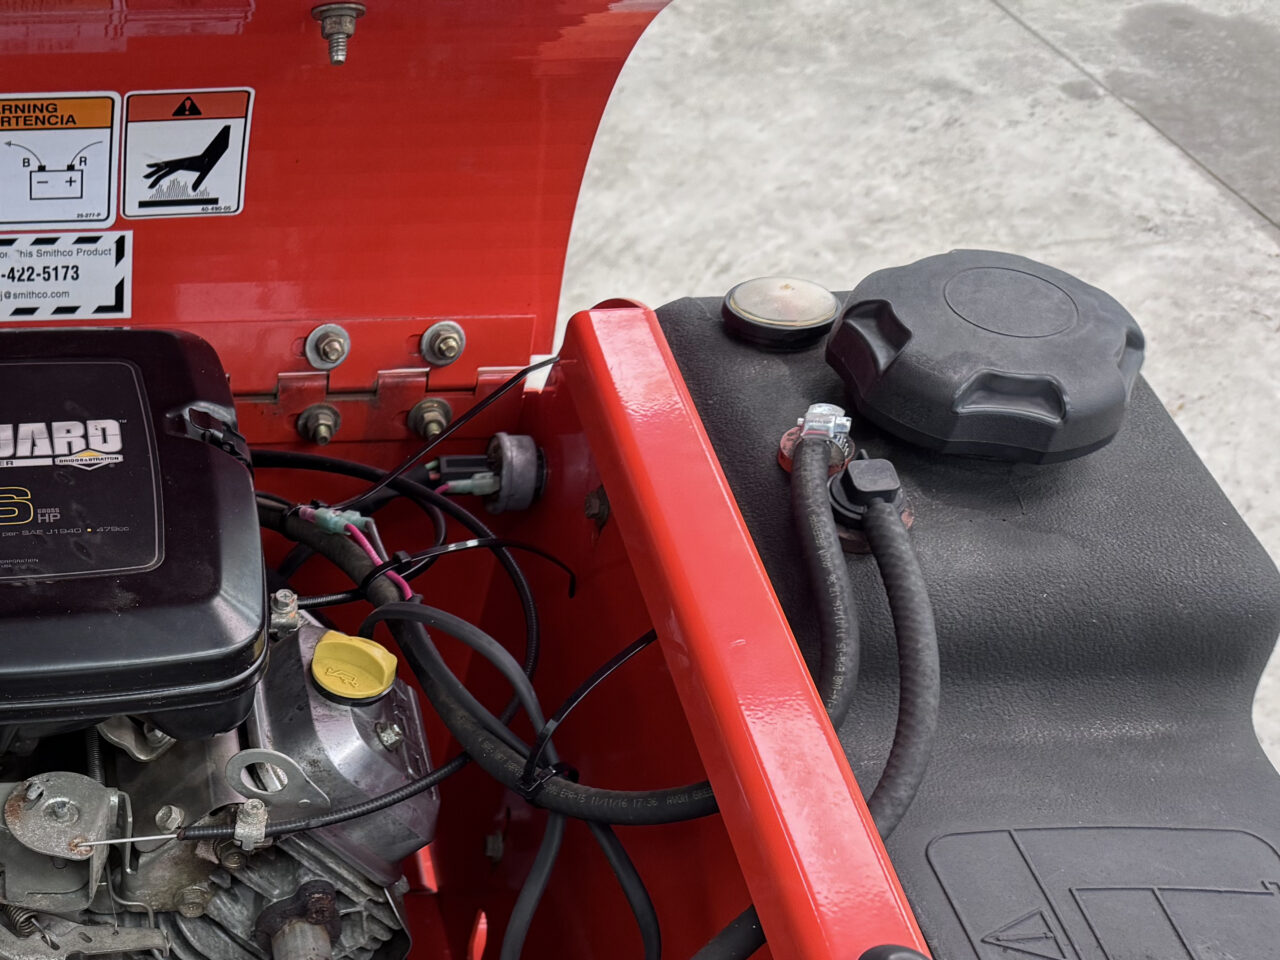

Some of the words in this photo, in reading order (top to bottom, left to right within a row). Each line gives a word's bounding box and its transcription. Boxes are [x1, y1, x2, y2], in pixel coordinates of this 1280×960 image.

[22, 157, 31, 168] B
[79, 156, 88, 167] R
[36, 249, 73, 258] Smithco
[76, 247, 112, 257] Product
[37, 513, 61, 523] HP
